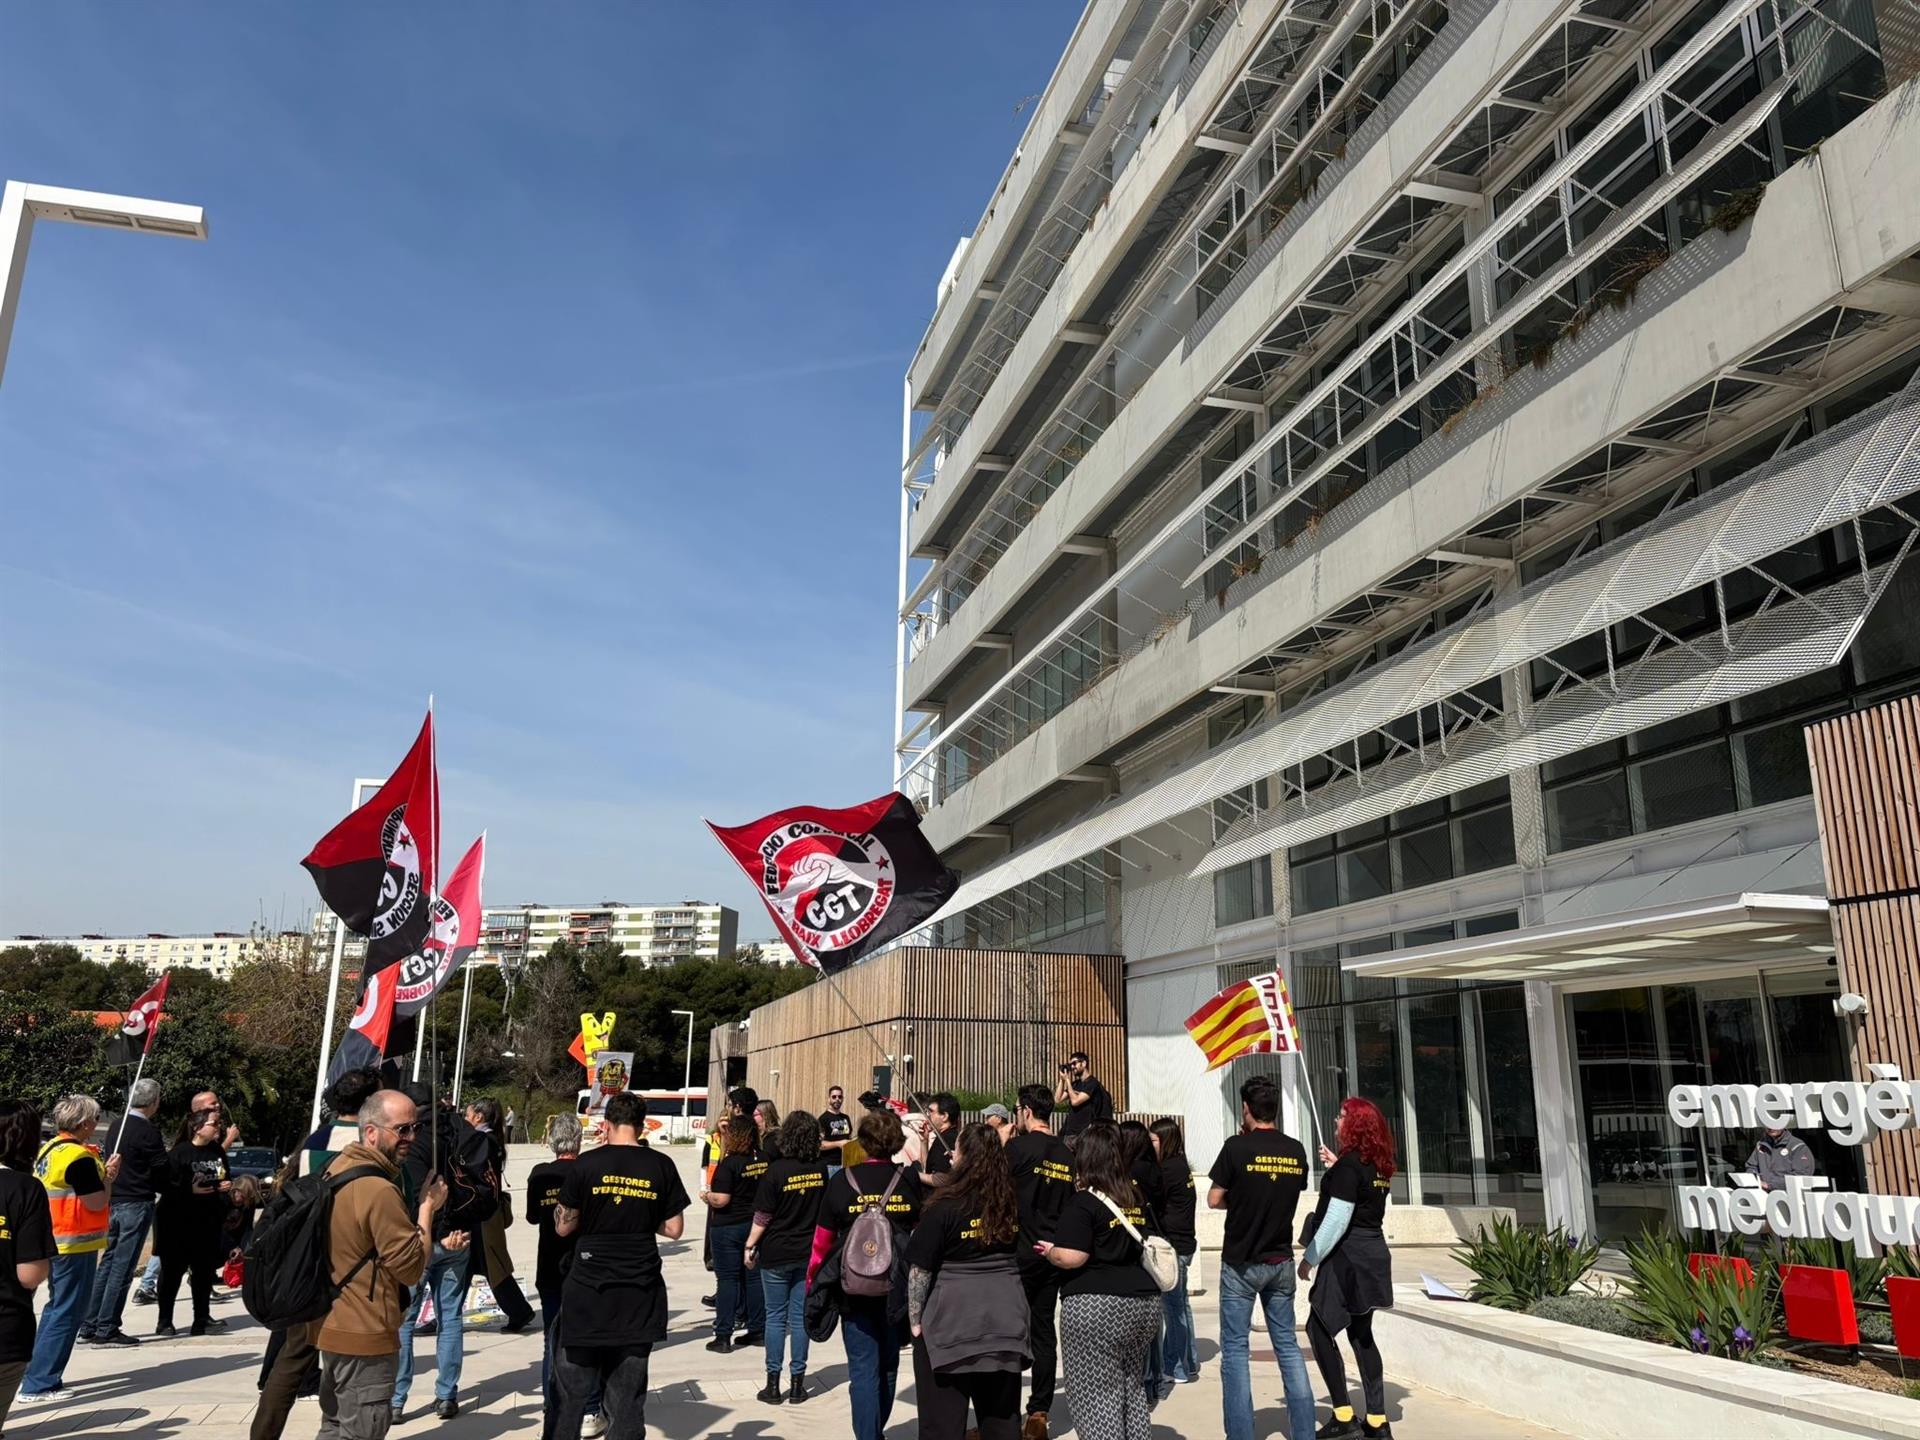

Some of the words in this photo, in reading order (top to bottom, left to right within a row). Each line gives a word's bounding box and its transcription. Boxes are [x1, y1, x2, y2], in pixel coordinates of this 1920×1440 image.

[791, 921, 822, 949] BAIX
[830, 878, 893, 948] LLOBREGAT
[806, 883, 861, 929] CGT
[1668, 1063, 1920, 1146] emergè
[1255, 1156, 1298, 1166] GESTORES
[602, 1175, 651, 1189] GESTORES
[787, 1172, 823, 1183] GESTORES
[856, 1194, 903, 1204] GESTES
[1679, 1173, 1920, 1259] mèdiqu
